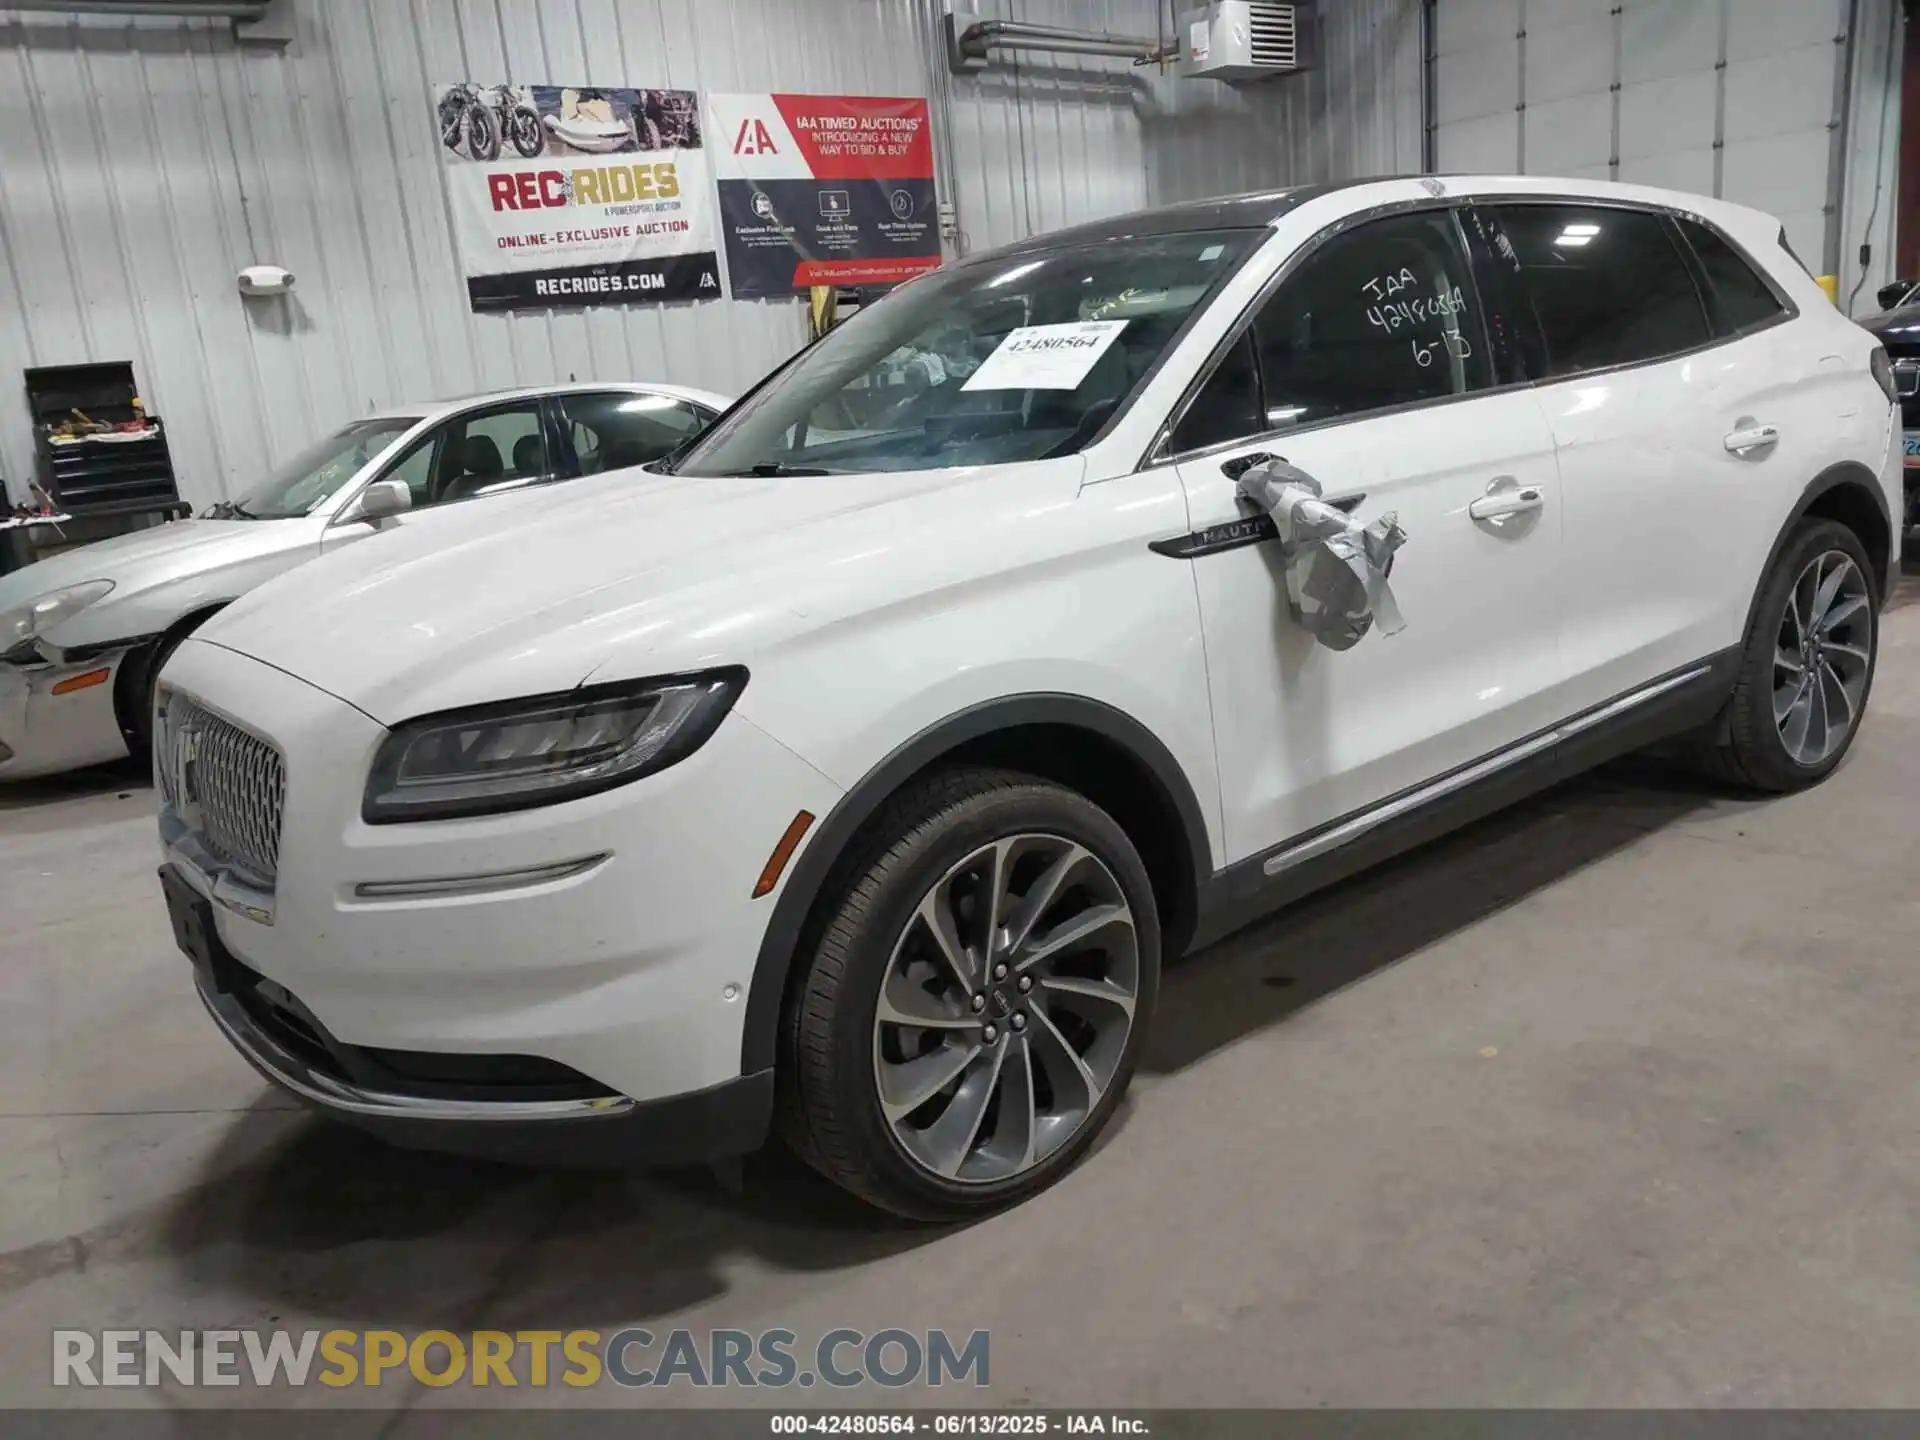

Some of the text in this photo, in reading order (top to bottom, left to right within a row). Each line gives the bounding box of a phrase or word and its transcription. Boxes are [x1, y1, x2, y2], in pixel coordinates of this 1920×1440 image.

[796, 116, 818, 129] IAA
[819, 117, 857, 130] TIMED
[812, 131, 913, 143] INTRODUCING A NEW
[819, 144, 842, 155] WAY
[844, 144, 858, 155] TO
[860, 145, 876, 155] BID
[888, 145, 909, 156] BUY
[487, 163, 680, 212] REC RIDES
[609, 203, 655, 217] POWERSPORT
[655, 201, 681, 214] AUCTION
[497, 225, 632, 249] ONLINE-EXCLUSIVE
[635, 219, 690, 236] AUCTION
[535, 273, 666, 296] RECRIDES.COM
[1361, 267, 1418, 301] IAA
[1007, 335, 1101, 352] 42480564
[1411, 328, 1472, 367] 6-13
